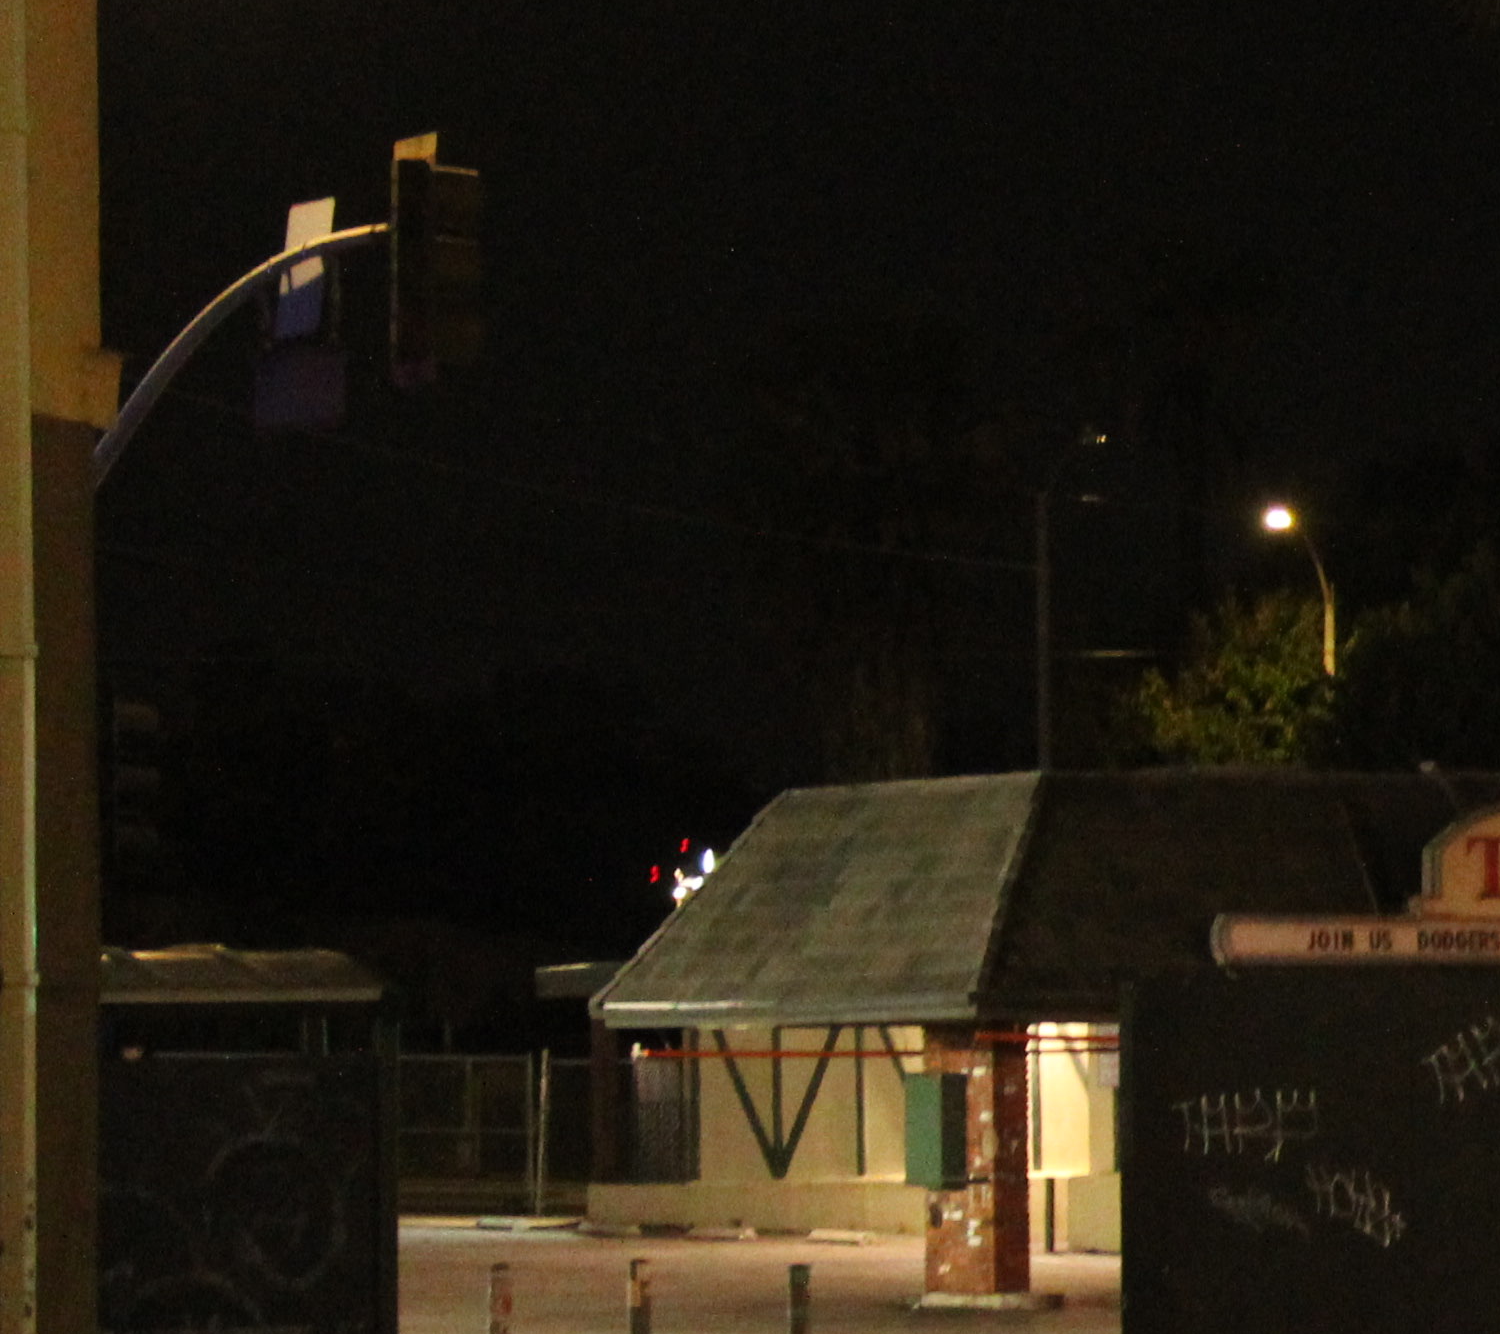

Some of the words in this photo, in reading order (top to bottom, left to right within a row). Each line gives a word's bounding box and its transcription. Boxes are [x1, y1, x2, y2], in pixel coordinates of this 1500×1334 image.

[1306, 930, 1355, 952] JOIN
[1370, 930, 1393, 952] US
[1417, 930, 1500, 952] DODGERS
